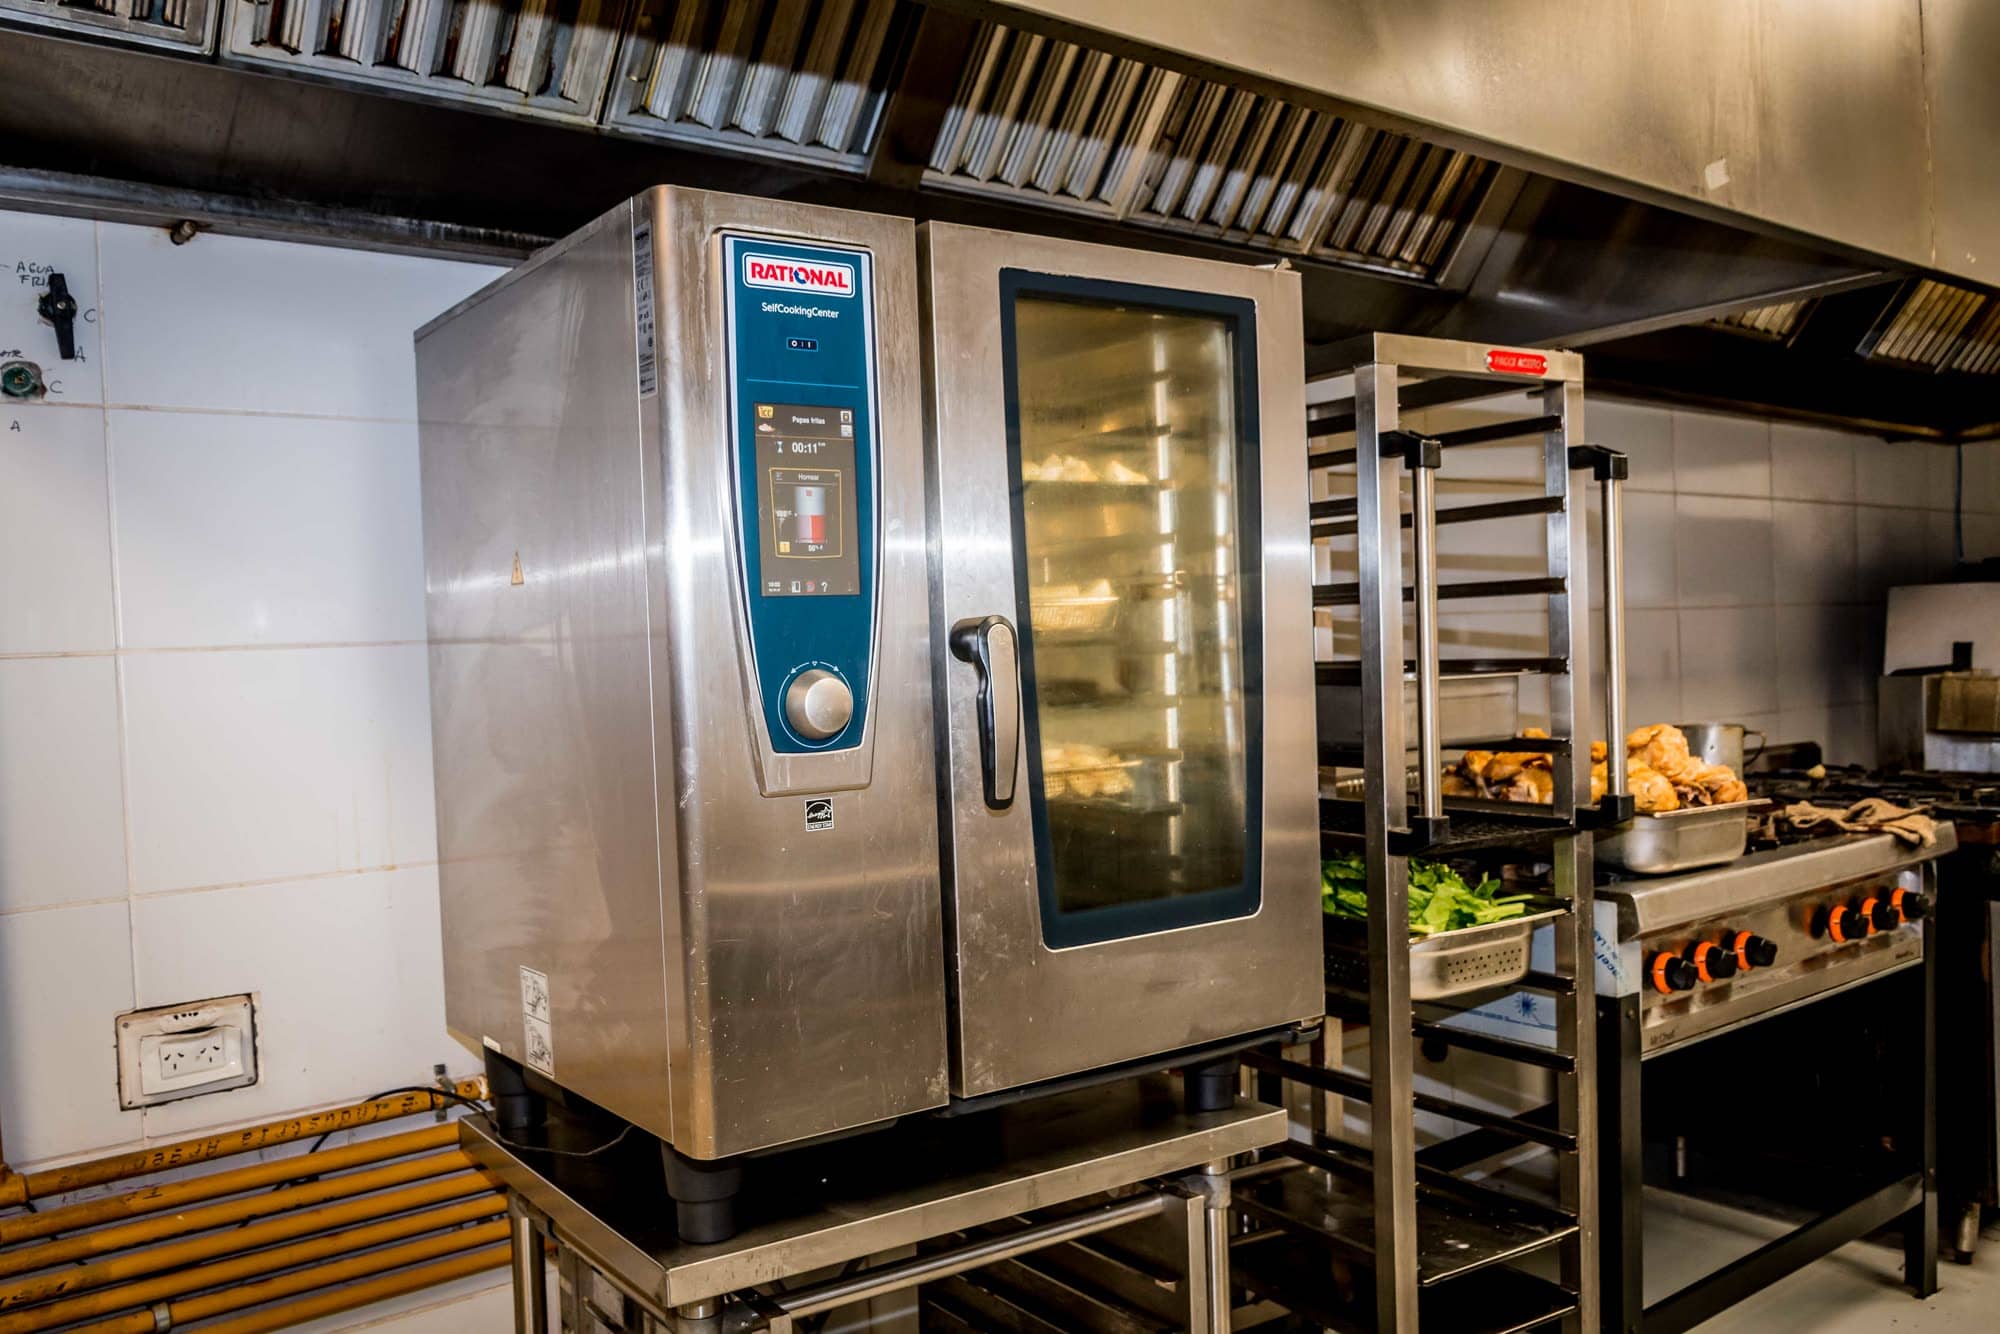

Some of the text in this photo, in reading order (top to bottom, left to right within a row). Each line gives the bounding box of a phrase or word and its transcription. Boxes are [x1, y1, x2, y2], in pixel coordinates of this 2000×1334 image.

[19, 275, 51, 288] FRI
[750, 262, 849, 288] RATIONAL
[761, 301, 840, 319] SelfCookingCenter
[791, 441, 818, 454] 00:11
